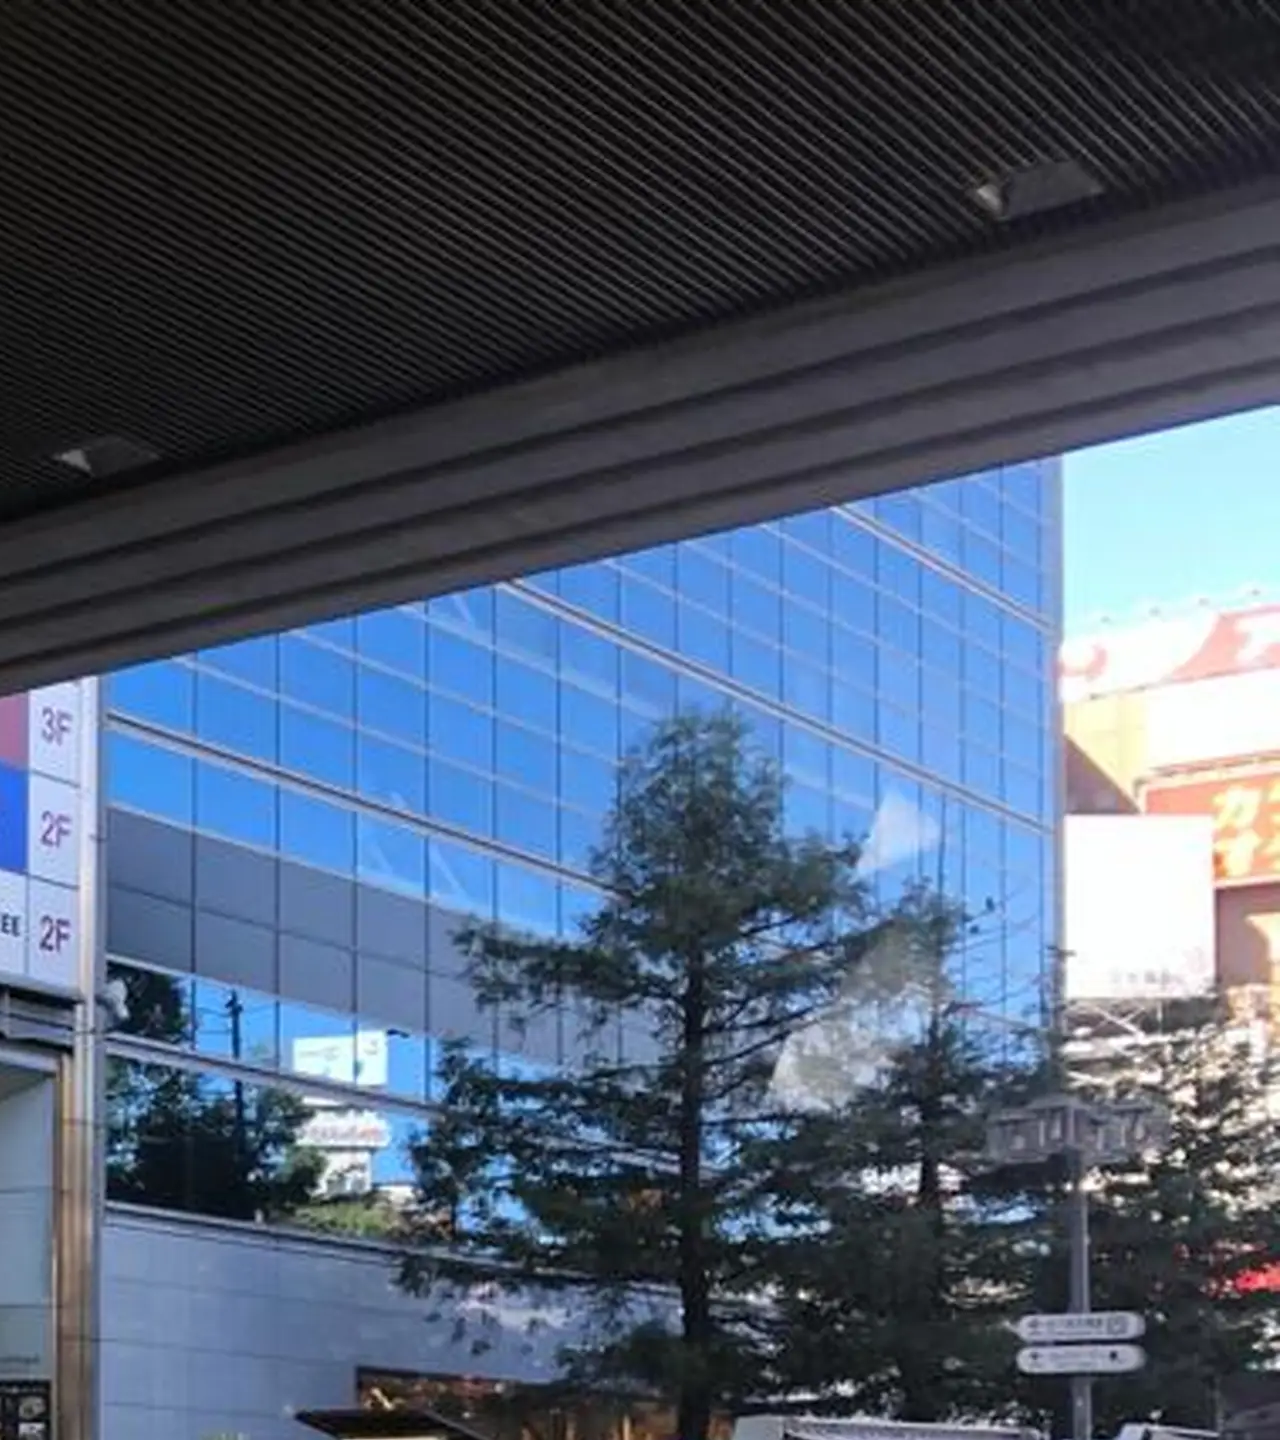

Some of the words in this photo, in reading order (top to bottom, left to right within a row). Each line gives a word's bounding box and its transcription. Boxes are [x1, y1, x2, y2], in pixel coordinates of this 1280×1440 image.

[40, 706, 72, 746] 3F
[40, 812, 72, 848] 2F
[38, 915, 71, 952] 2F
